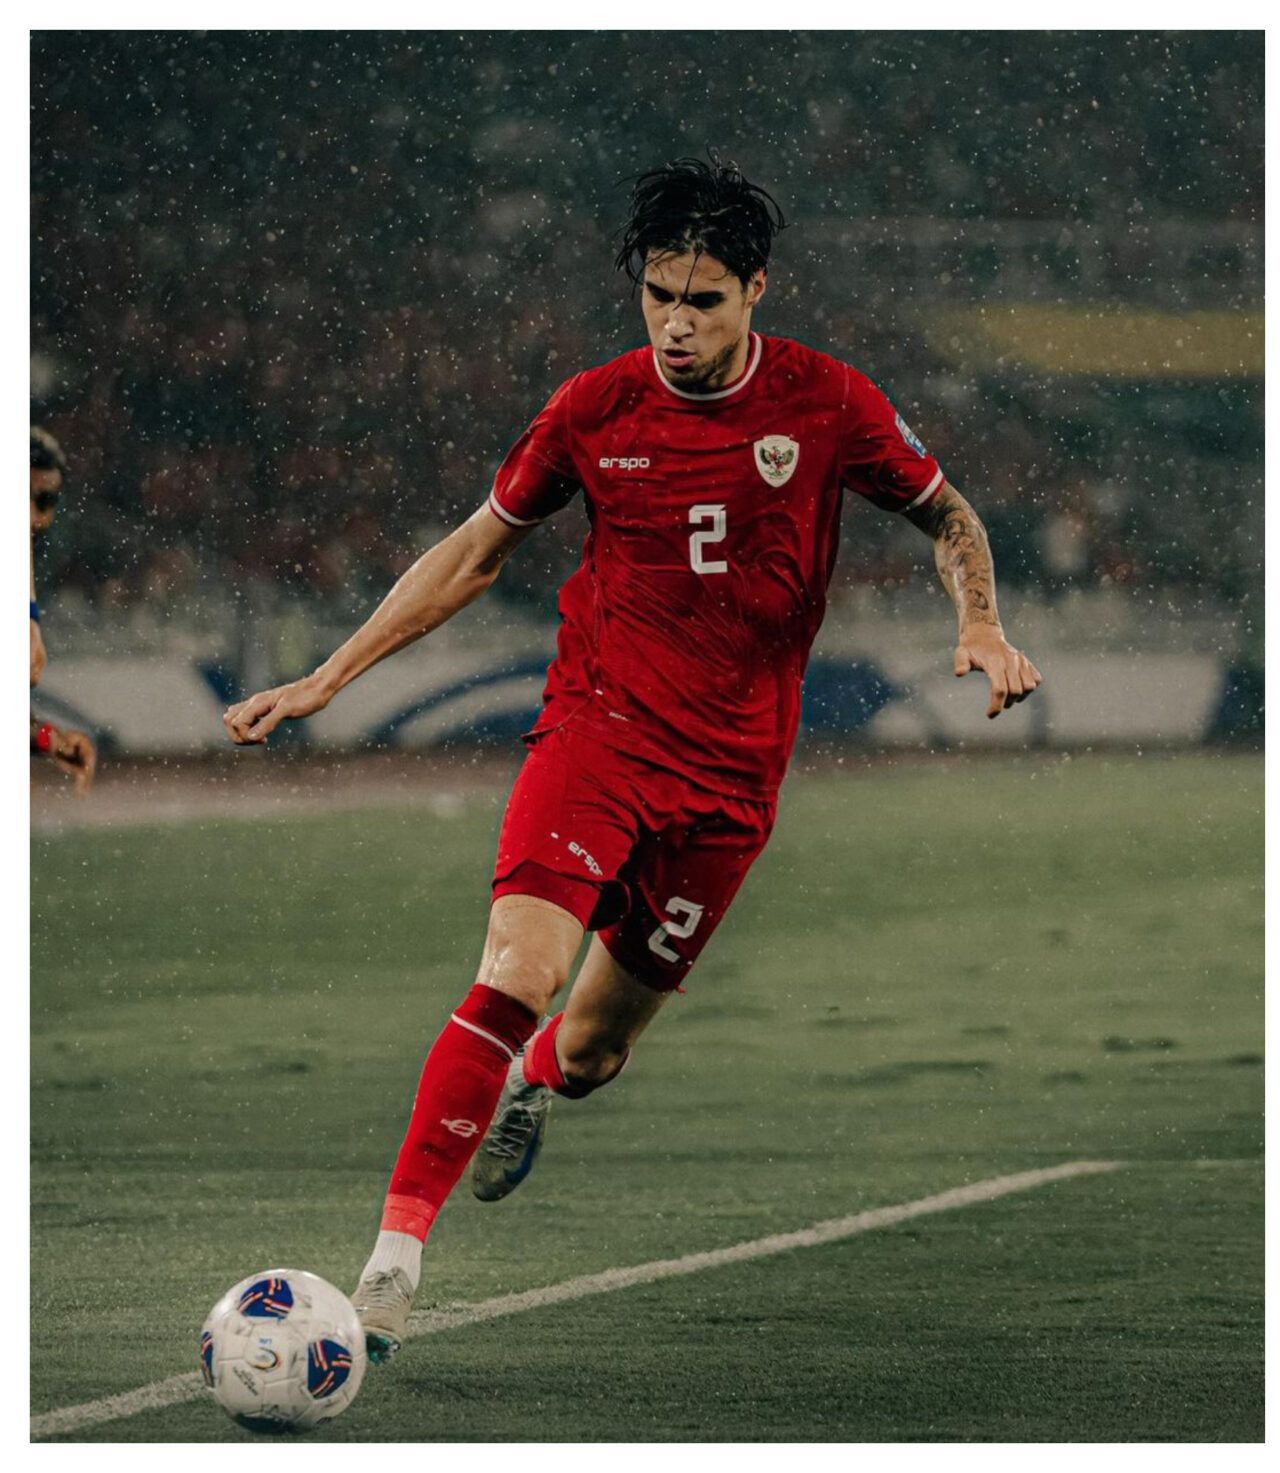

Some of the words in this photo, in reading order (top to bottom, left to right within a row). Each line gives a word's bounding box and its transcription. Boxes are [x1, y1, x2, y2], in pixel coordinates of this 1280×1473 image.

[599, 456, 650, 471] erspo
[688, 504, 728, 575] 2
[648, 896, 705, 963] 2
